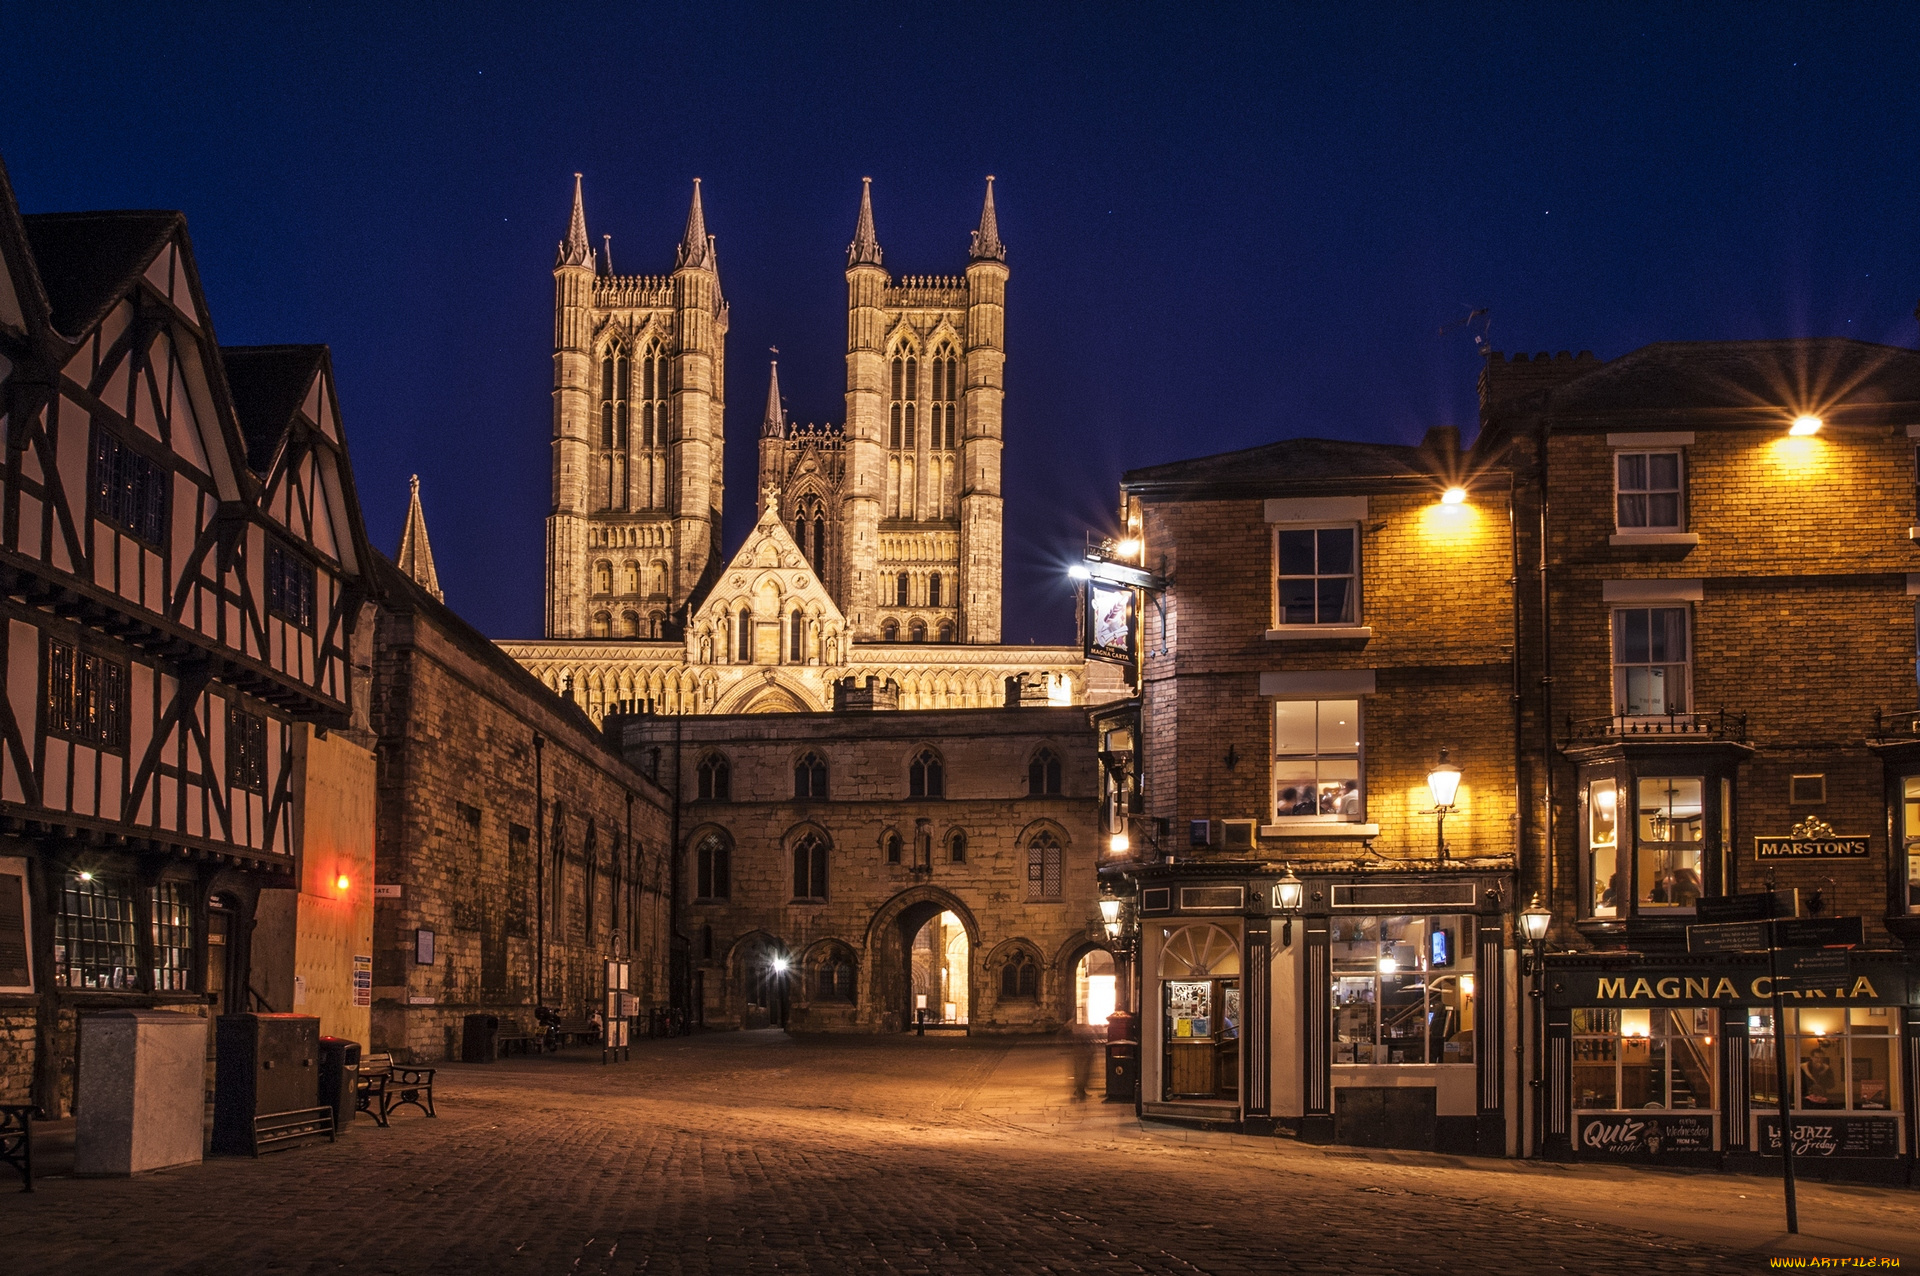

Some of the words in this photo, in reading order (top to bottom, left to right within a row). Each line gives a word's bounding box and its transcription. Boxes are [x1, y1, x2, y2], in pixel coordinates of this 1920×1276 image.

[1090, 648, 1112, 657] MAGNA
[1112, 652, 1129, 661] CARTA
[1761, 841, 1865, 855] MARSTON'S
[1596, 976, 1741, 999] MAGNA
[1666, 1125, 1709, 1138] Wednesday
[1794, 1125, 1833, 1140] JAZZ
[1609, 1142, 1642, 1155] night
